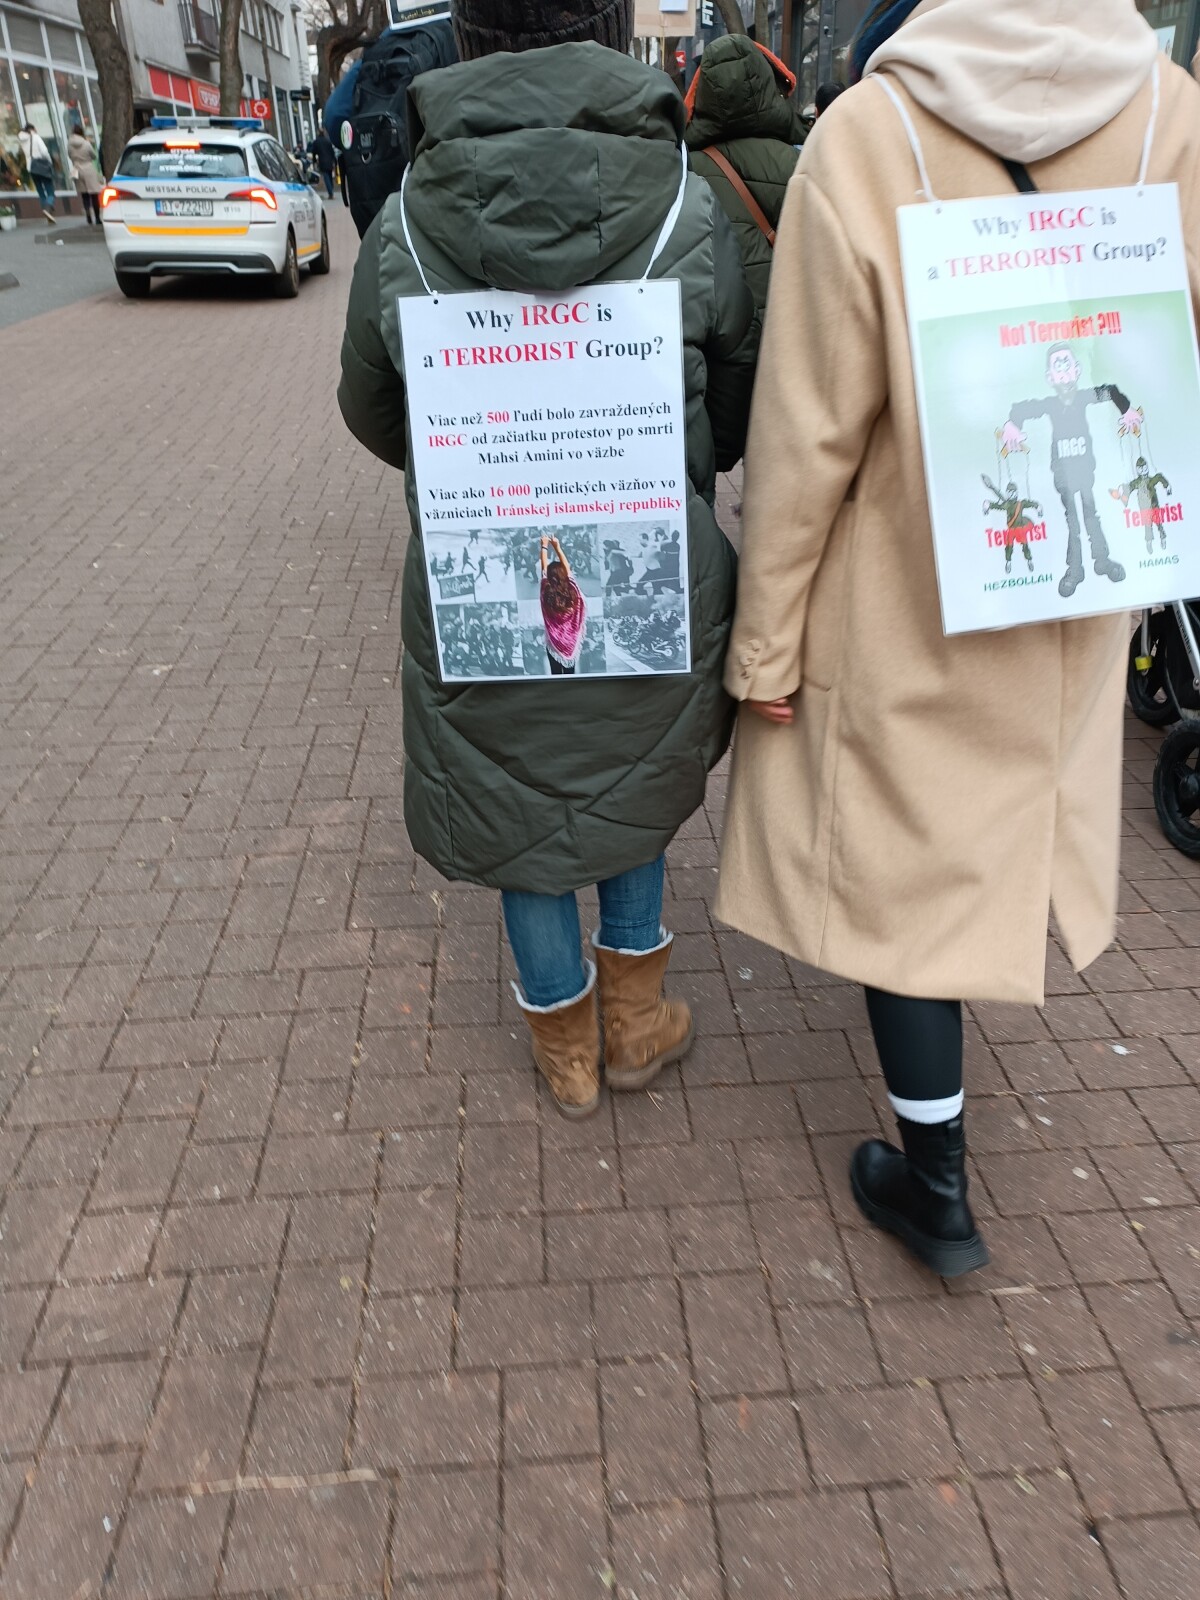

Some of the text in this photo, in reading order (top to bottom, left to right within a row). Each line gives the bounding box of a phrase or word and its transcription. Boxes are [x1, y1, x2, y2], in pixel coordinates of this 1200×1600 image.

[145, 185, 217, 194] MESTSKÁ POLÍCIA
[972, 206, 1117, 239] Why IRGC is
[927, 237, 1167, 280] a TERRORIST Group?
[465, 301, 612, 332] Why IRGC is
[999, 324, 1026, 347] Not
[1028, 316, 1096, 344] Terrorist
[423, 336, 664, 368] a TERRORIST Group?
[426, 402, 671, 427] Viac než 500 ľudí bolo zavraždených
[428, 422, 674, 447] IRGC od začiatku protestov po smrti
[1057, 436, 1087, 458] IRGC
[478, 446, 625, 465] Mahsi Amini vo väzbe
[428, 477, 676, 501] Viac ako 16 000 politických väzňov vo
[424, 496, 683, 521] väzniciach Iránskej islamskej republiky
[1139, 554, 1180, 569] HAMAS
[984, 573, 1053, 592] HEZBOLLAH
